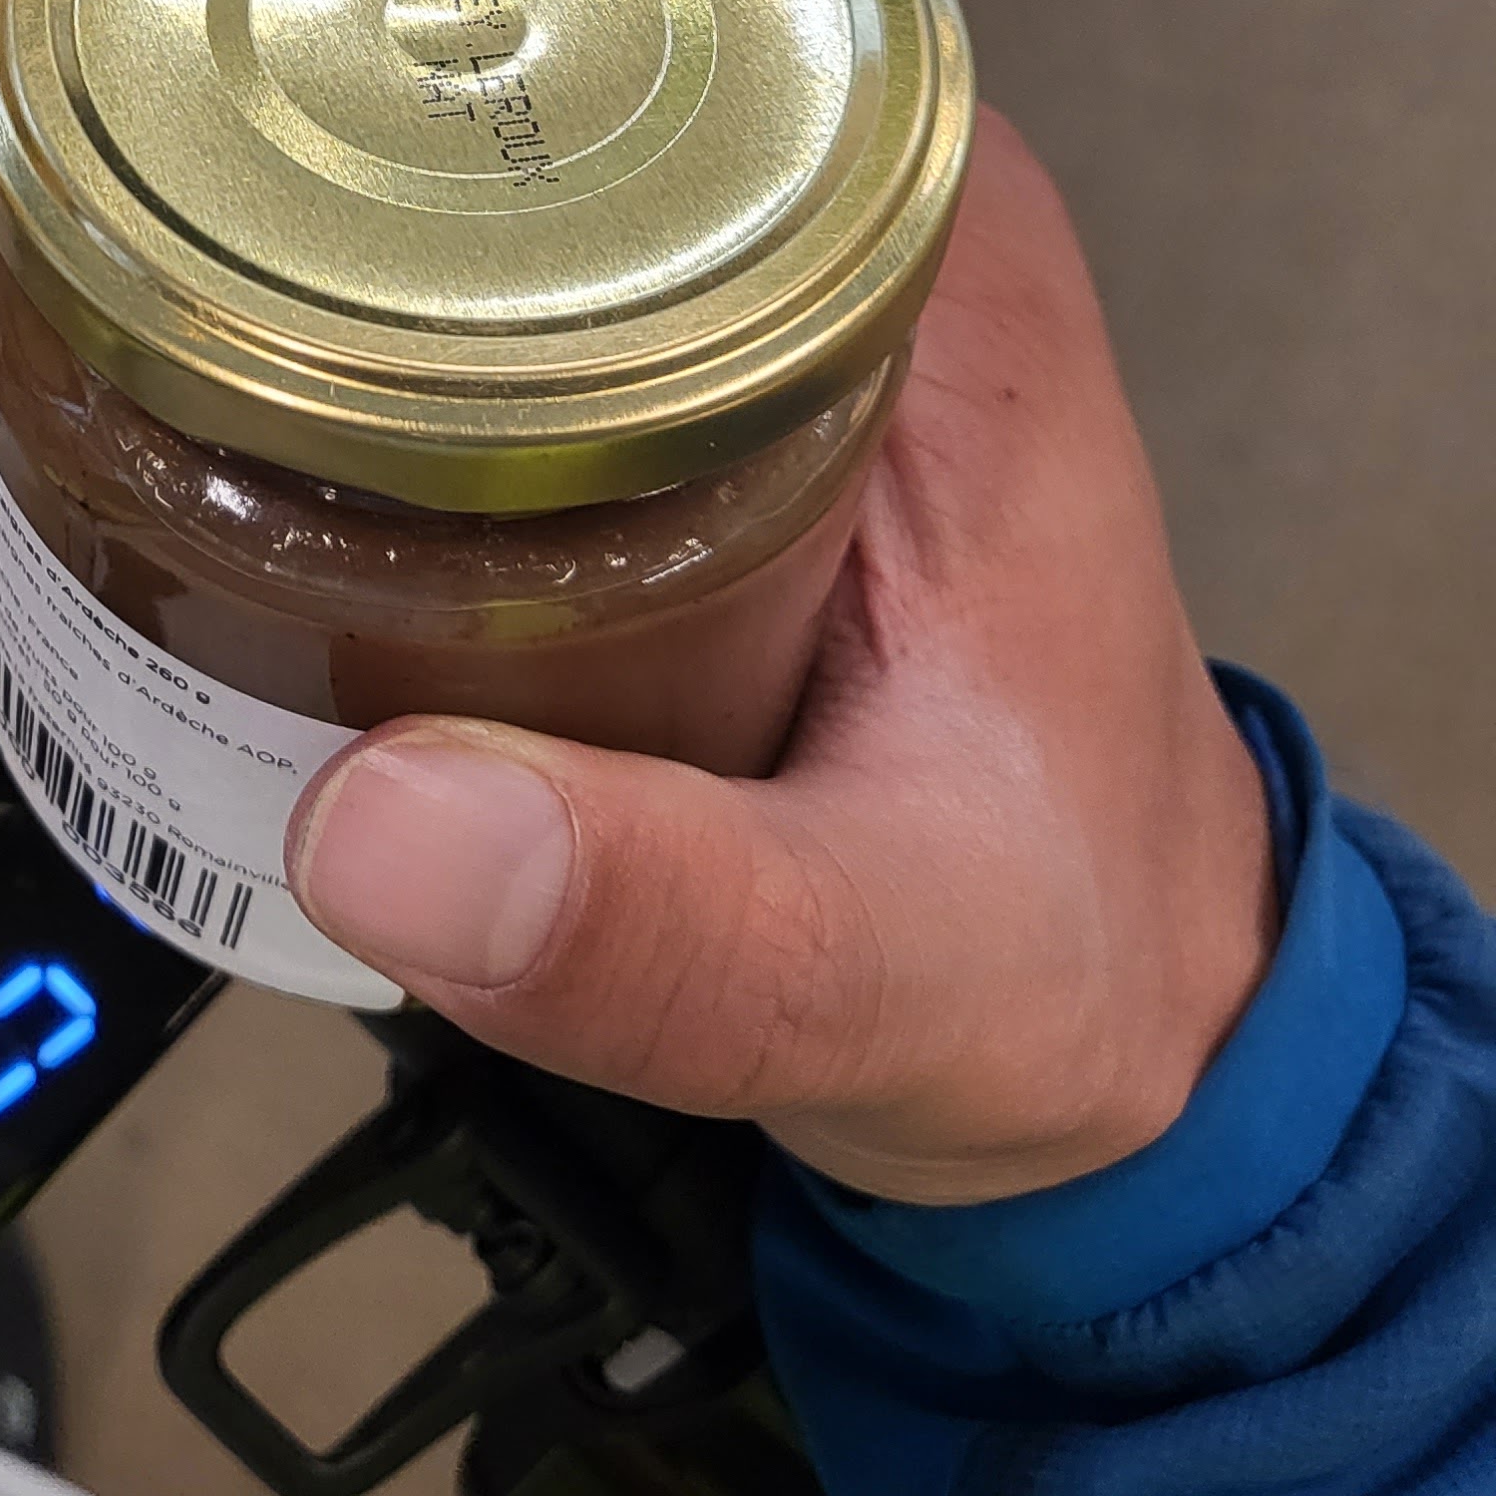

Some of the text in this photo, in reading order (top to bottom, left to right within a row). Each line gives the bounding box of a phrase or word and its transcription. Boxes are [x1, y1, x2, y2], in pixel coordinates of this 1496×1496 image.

[27, 613, 79, 681] France
[45, 566, 140, 660] d'Ardèche
[144, 656, 190, 692] 260
[194, 689, 212, 706] g
[62, 688, 98, 733] pour
[102, 733, 137, 767] 100
[116, 669, 230, 747] d'Ardèche
[236, 743, 299, 776] AOP.
[81, 725, 119, 770] pour
[125, 766, 163, 797] 100
[96, 776, 162, 825] 93230
